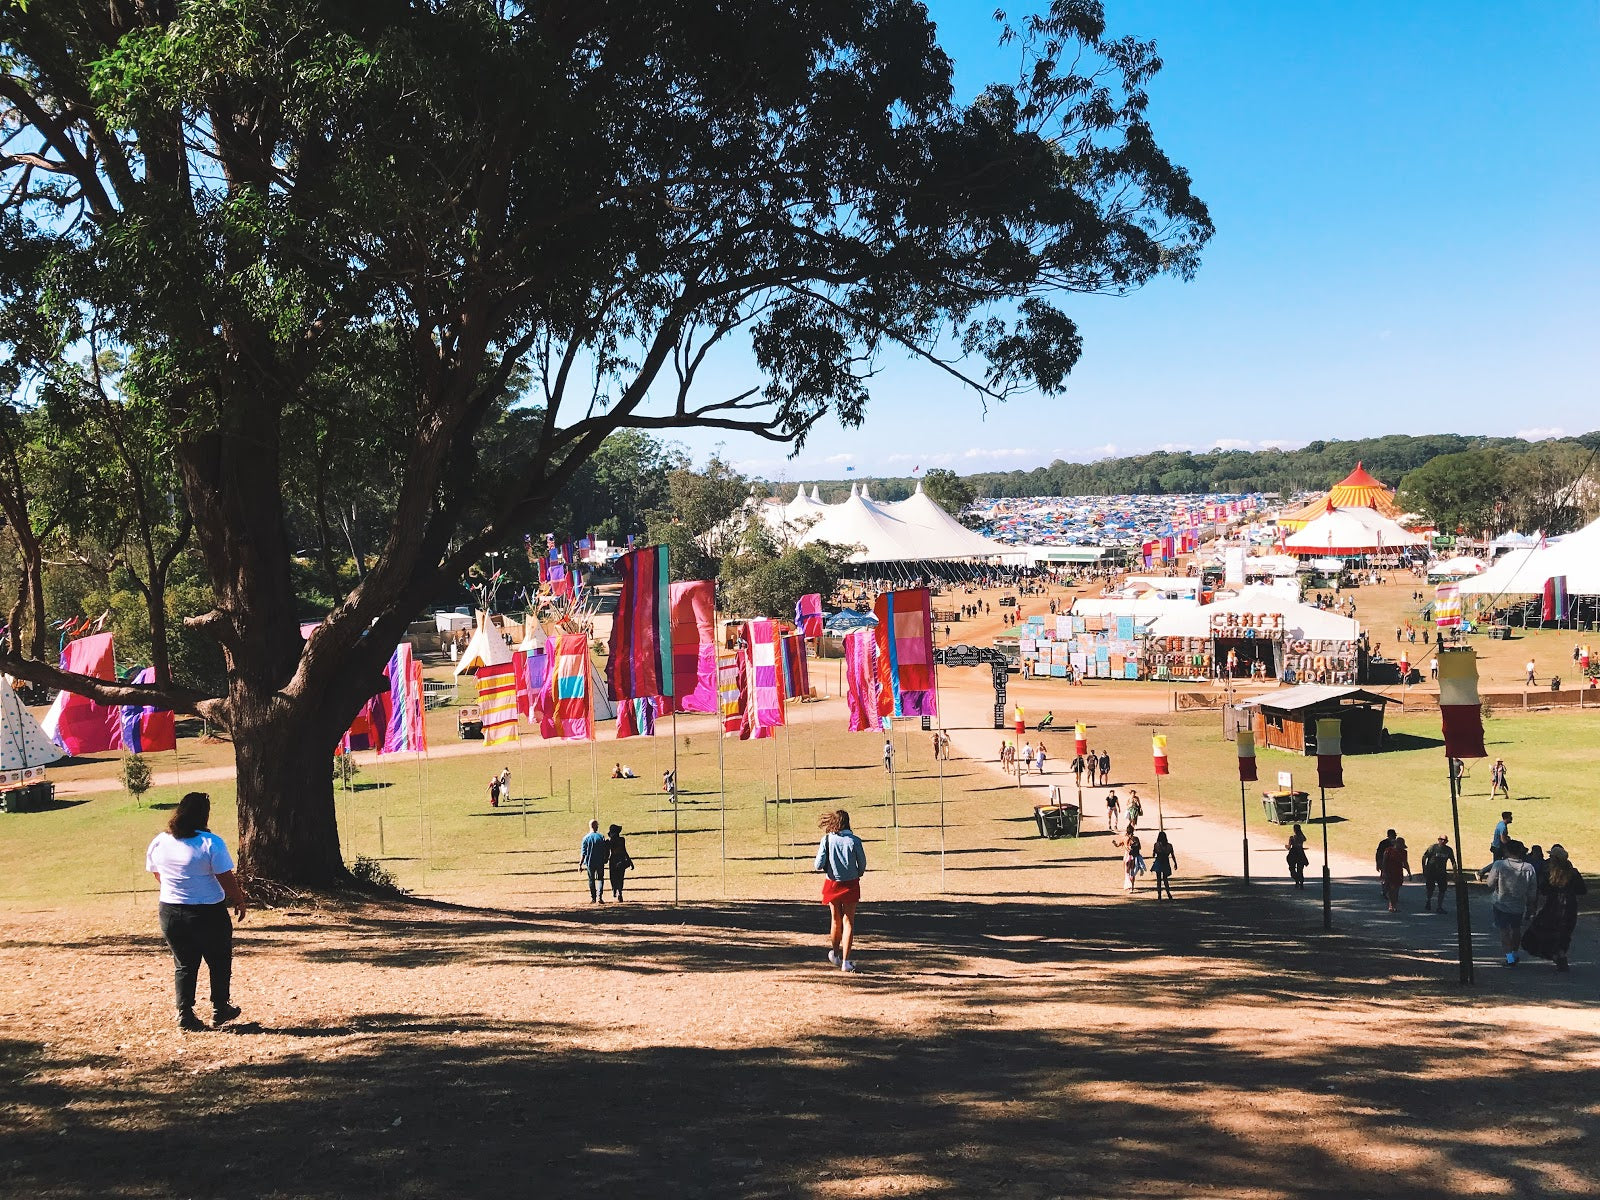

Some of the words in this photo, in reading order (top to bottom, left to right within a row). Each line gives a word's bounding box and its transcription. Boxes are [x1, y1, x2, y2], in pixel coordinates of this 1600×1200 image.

[1212, 612, 1282, 628] CRAFT
[1146, 635, 1211, 653] KNIT
[1146, 653, 1211, 666] HAPPENS
[1284, 654, 1354, 670] FINALLY
